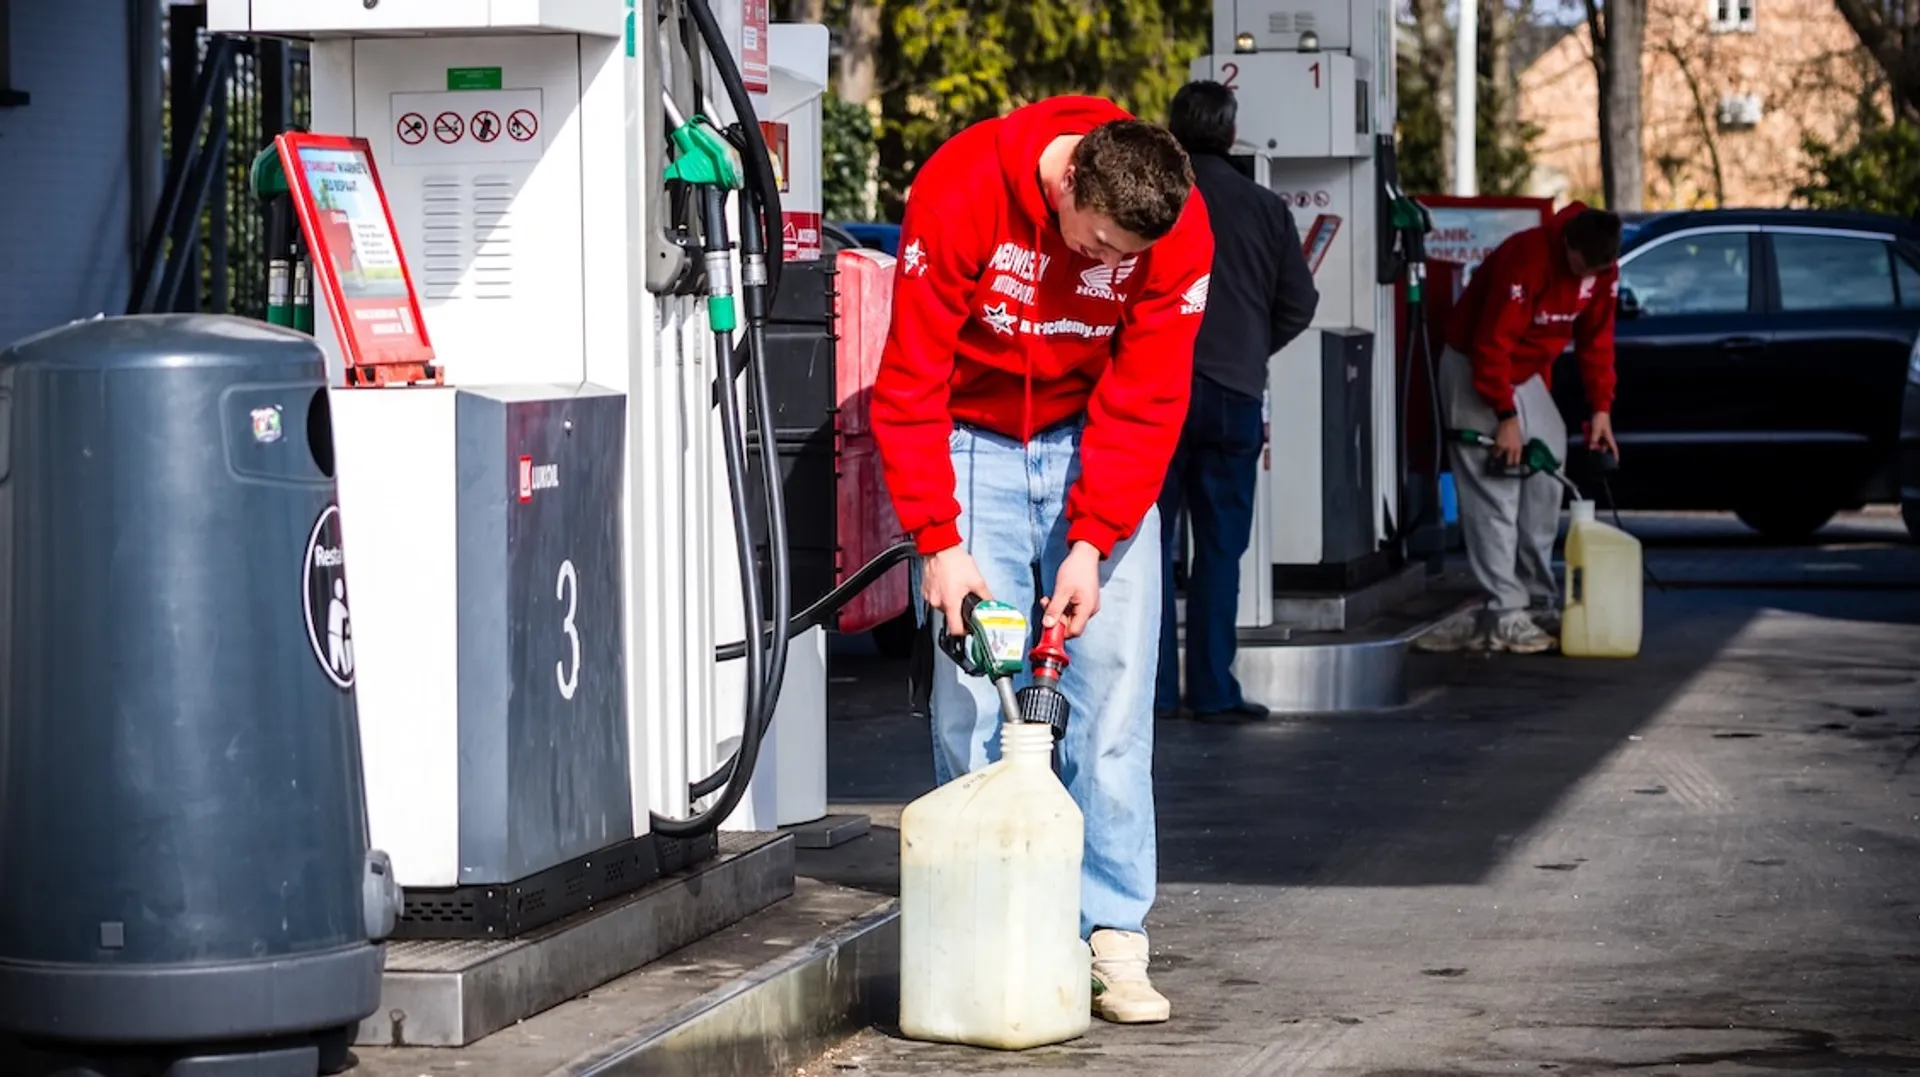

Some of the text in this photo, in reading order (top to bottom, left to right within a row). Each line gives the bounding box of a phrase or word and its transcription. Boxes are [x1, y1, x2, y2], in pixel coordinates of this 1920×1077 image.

[1221, 63, 1239, 90] 2
[1308, 62, 1320, 88] 1
[1429, 226, 1477, 242] ANK-
[1180, 303, 1206, 315] HO
[314, 544, 344, 568] Resta
[556, 559, 581, 700] 3
